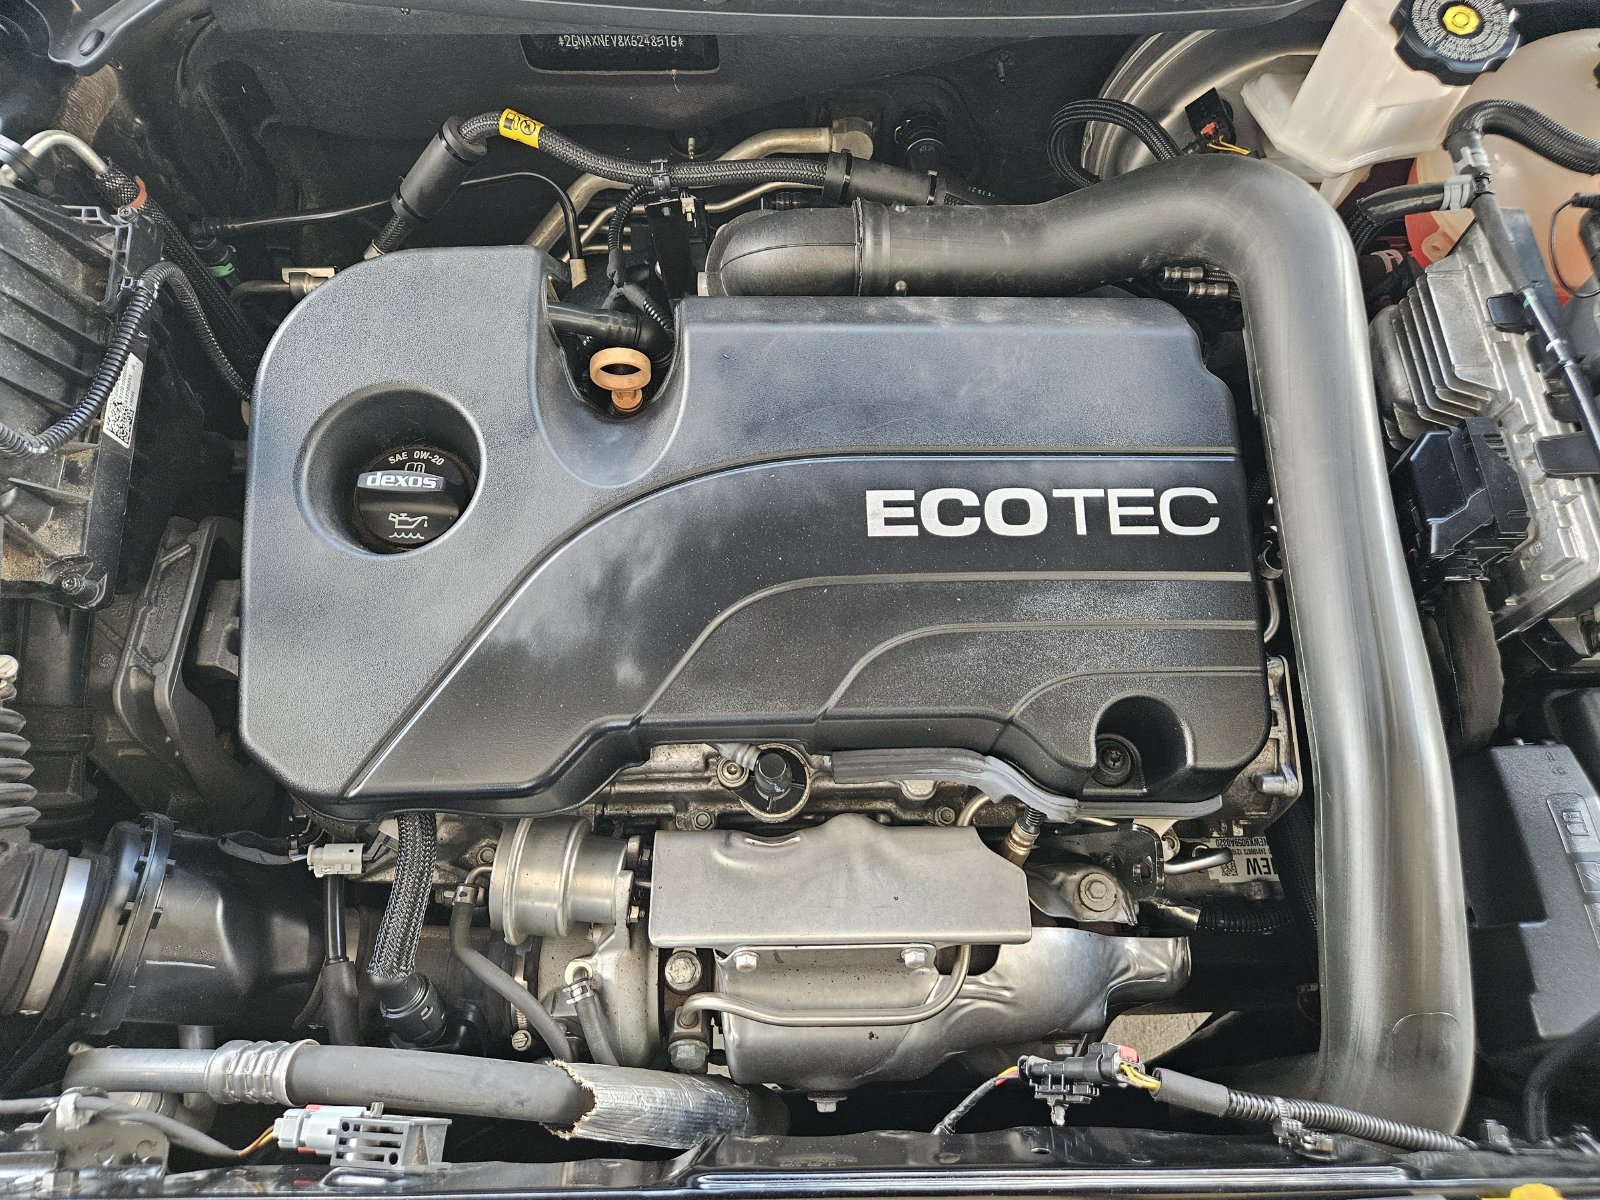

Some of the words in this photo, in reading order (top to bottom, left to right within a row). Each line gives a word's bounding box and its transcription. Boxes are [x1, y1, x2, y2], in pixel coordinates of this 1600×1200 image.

[388, 451, 409, 465] SAE
[413, 450, 445, 466] 0W-20
[366, 471, 437, 489] dexos
[865, 487, 1220, 537] ECOTEC
